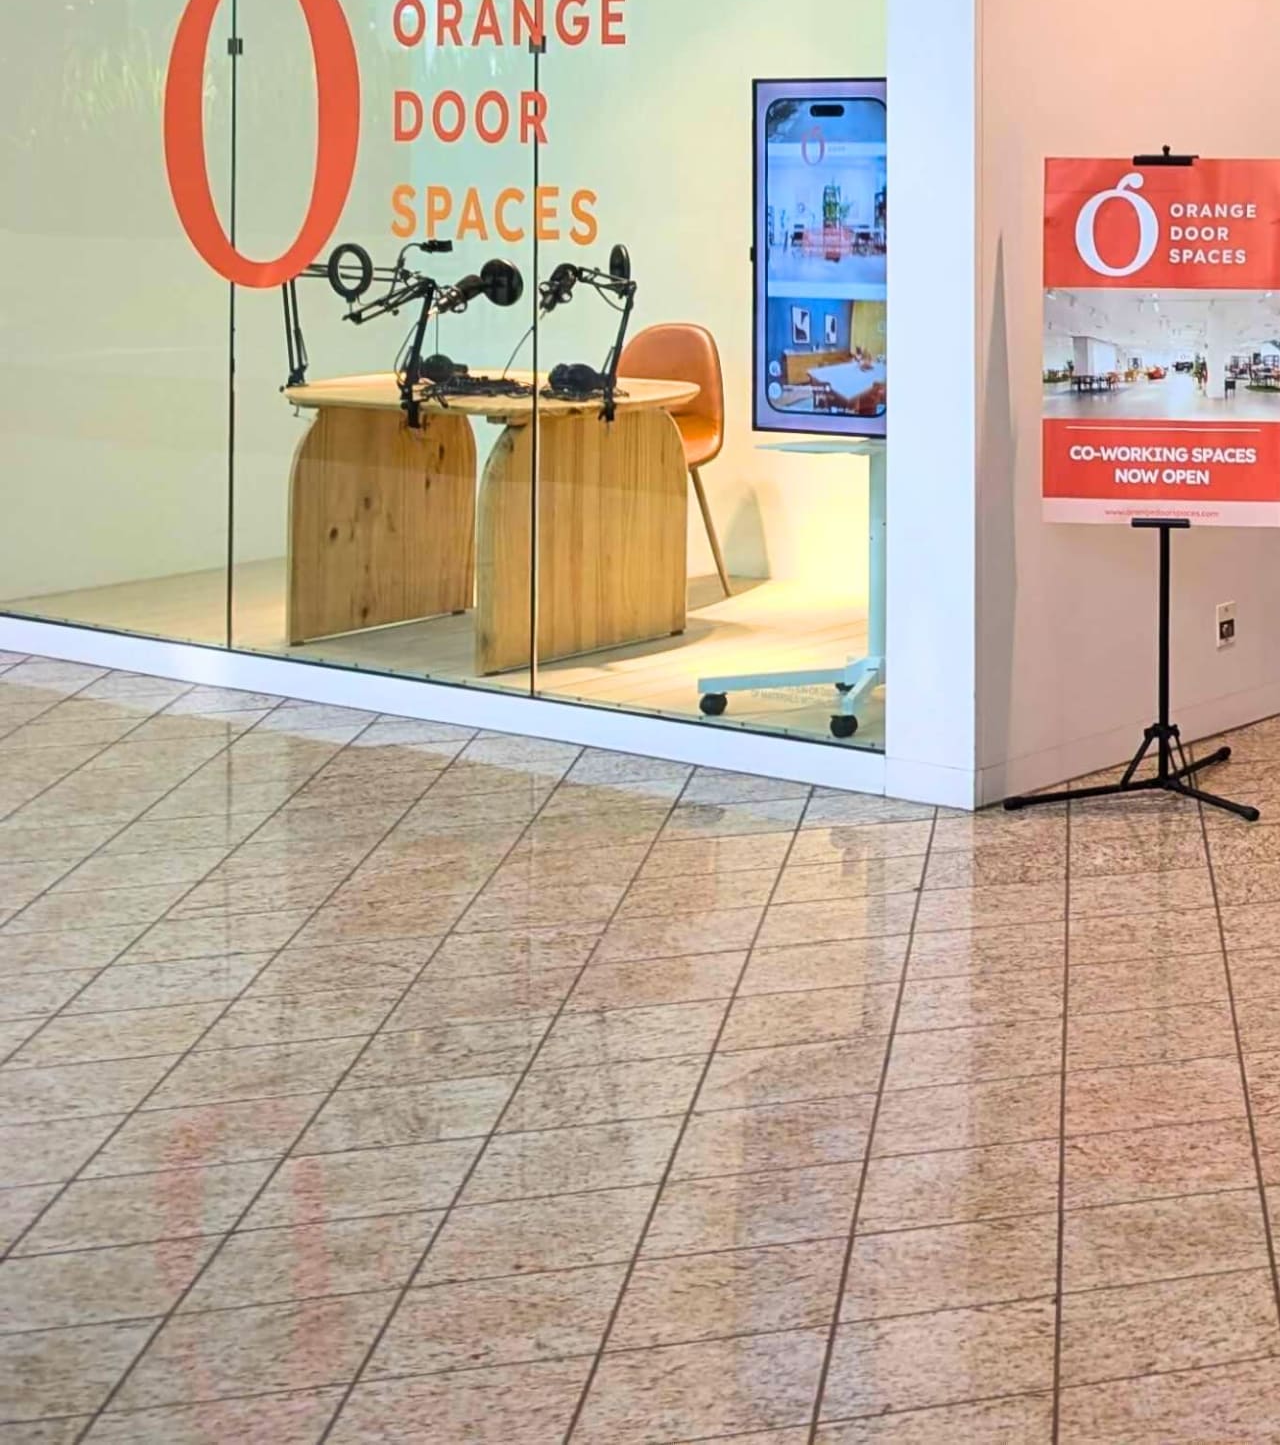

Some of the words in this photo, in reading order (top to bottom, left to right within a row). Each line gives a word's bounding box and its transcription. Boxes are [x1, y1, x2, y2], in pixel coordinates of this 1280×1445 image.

[392, 89, 550, 145] DOOR
[390, 182, 600, 247] SPACES
[1169, 202, 1258, 219] ORANGE
[1169, 225, 1230, 242] DOOR
[1168, 247, 1247, 265] SPACES
[1069, 445, 1189, 464] CO-WORKING
[1191, 447, 1257, 464] SPACES
[1114, 468, 1160, 485] NOW
[1162, 468, 1210, 485] OPEN
